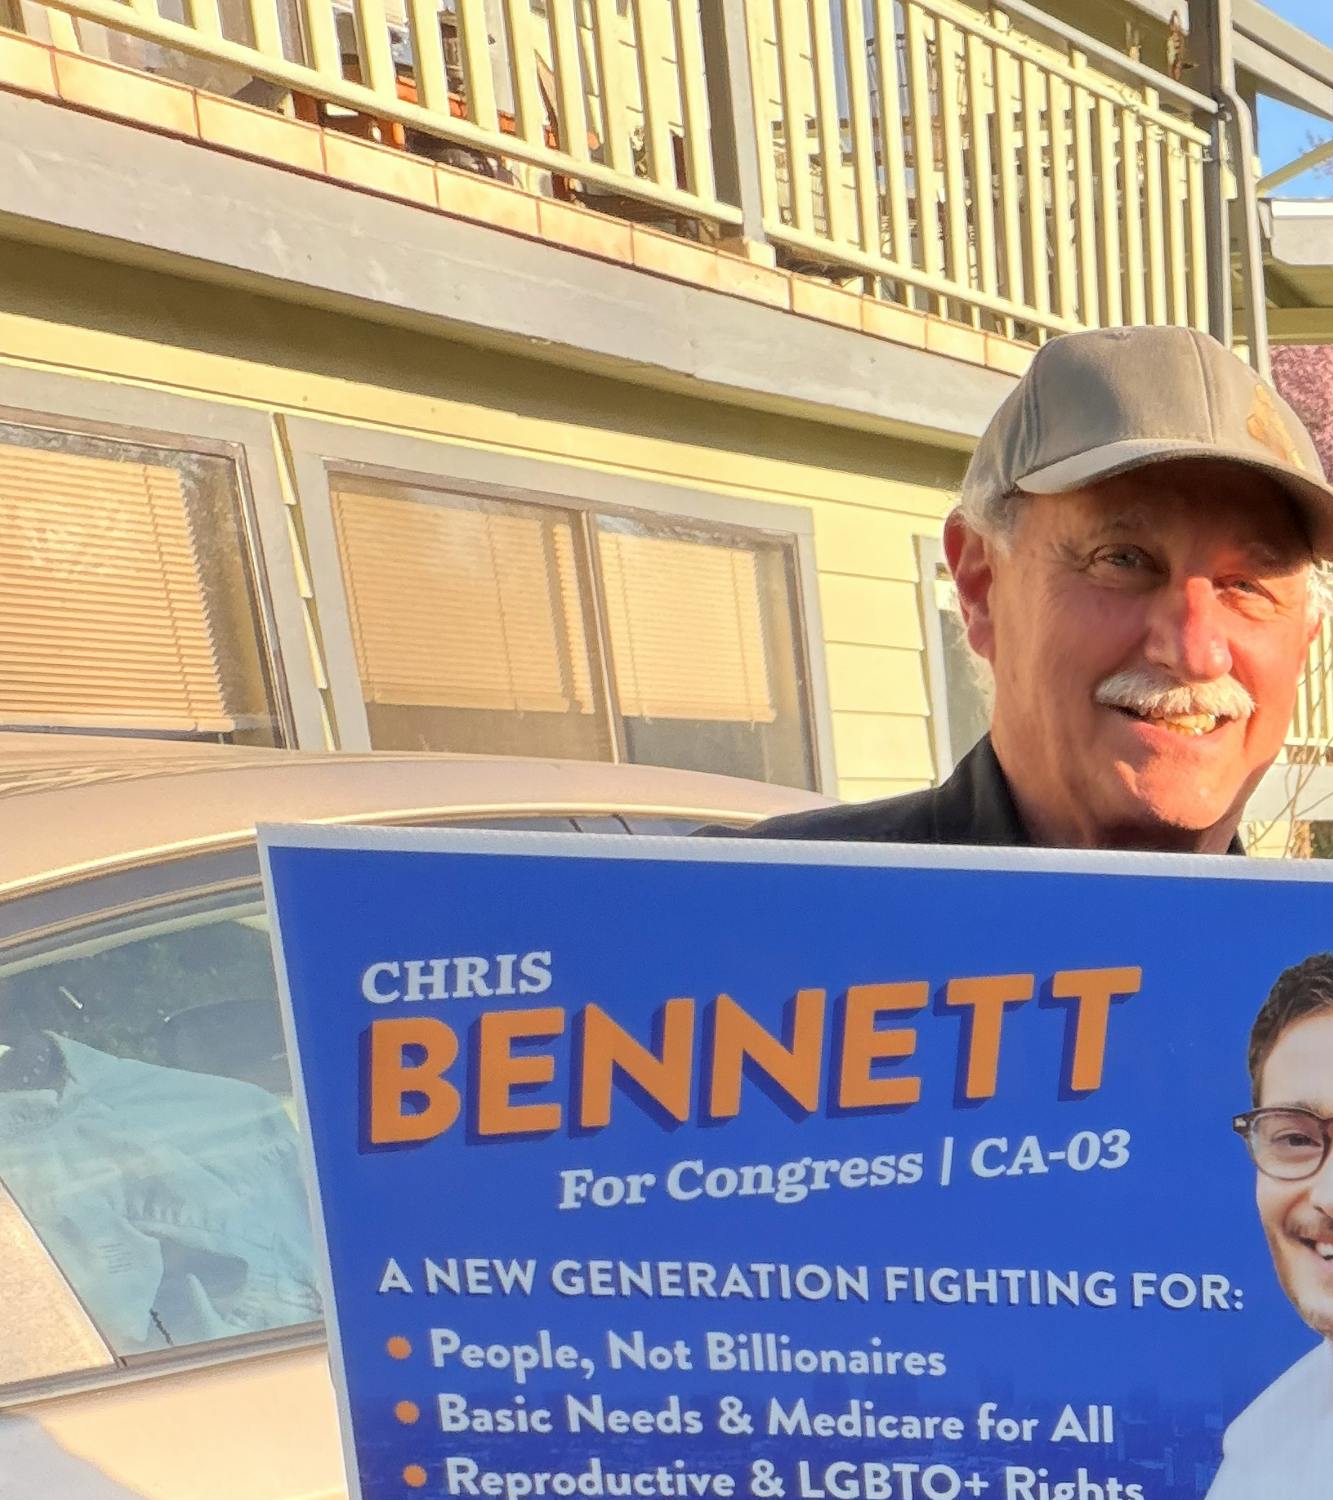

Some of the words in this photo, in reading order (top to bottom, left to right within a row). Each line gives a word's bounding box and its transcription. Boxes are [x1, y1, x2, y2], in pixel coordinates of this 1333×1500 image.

[361, 951, 552, 1004] CHRIS
[364, 967, 1142, 1148] BENNETT
[559, 1169, 657, 1210] For
[666, 1153, 923, 1204] Congress
[970, 1128, 1131, 1178] CA-03
[378, 1256, 413, 1293] A
[424, 1257, 536, 1295] NEW
[551, 1259, 870, 1301] GENERATION
[885, 1266, 1118, 1307] FIGHTING
[1132, 1272, 1246, 1310] FOR:
[430, 1328, 595, 1384] People,
[608, 1330, 693, 1370] Not
[706, 1331, 947, 1376] Billionaires
[437, 1393, 553, 1433] Basic
[566, 1394, 703, 1434] Needs
[718, 1395, 754, 1435] &
[768, 1397, 965, 1440] Medicare
[977, 1402, 1039, 1441] for
[1050, 1404, 1114, 1443] All
[750, 1459, 786, 1498] &
